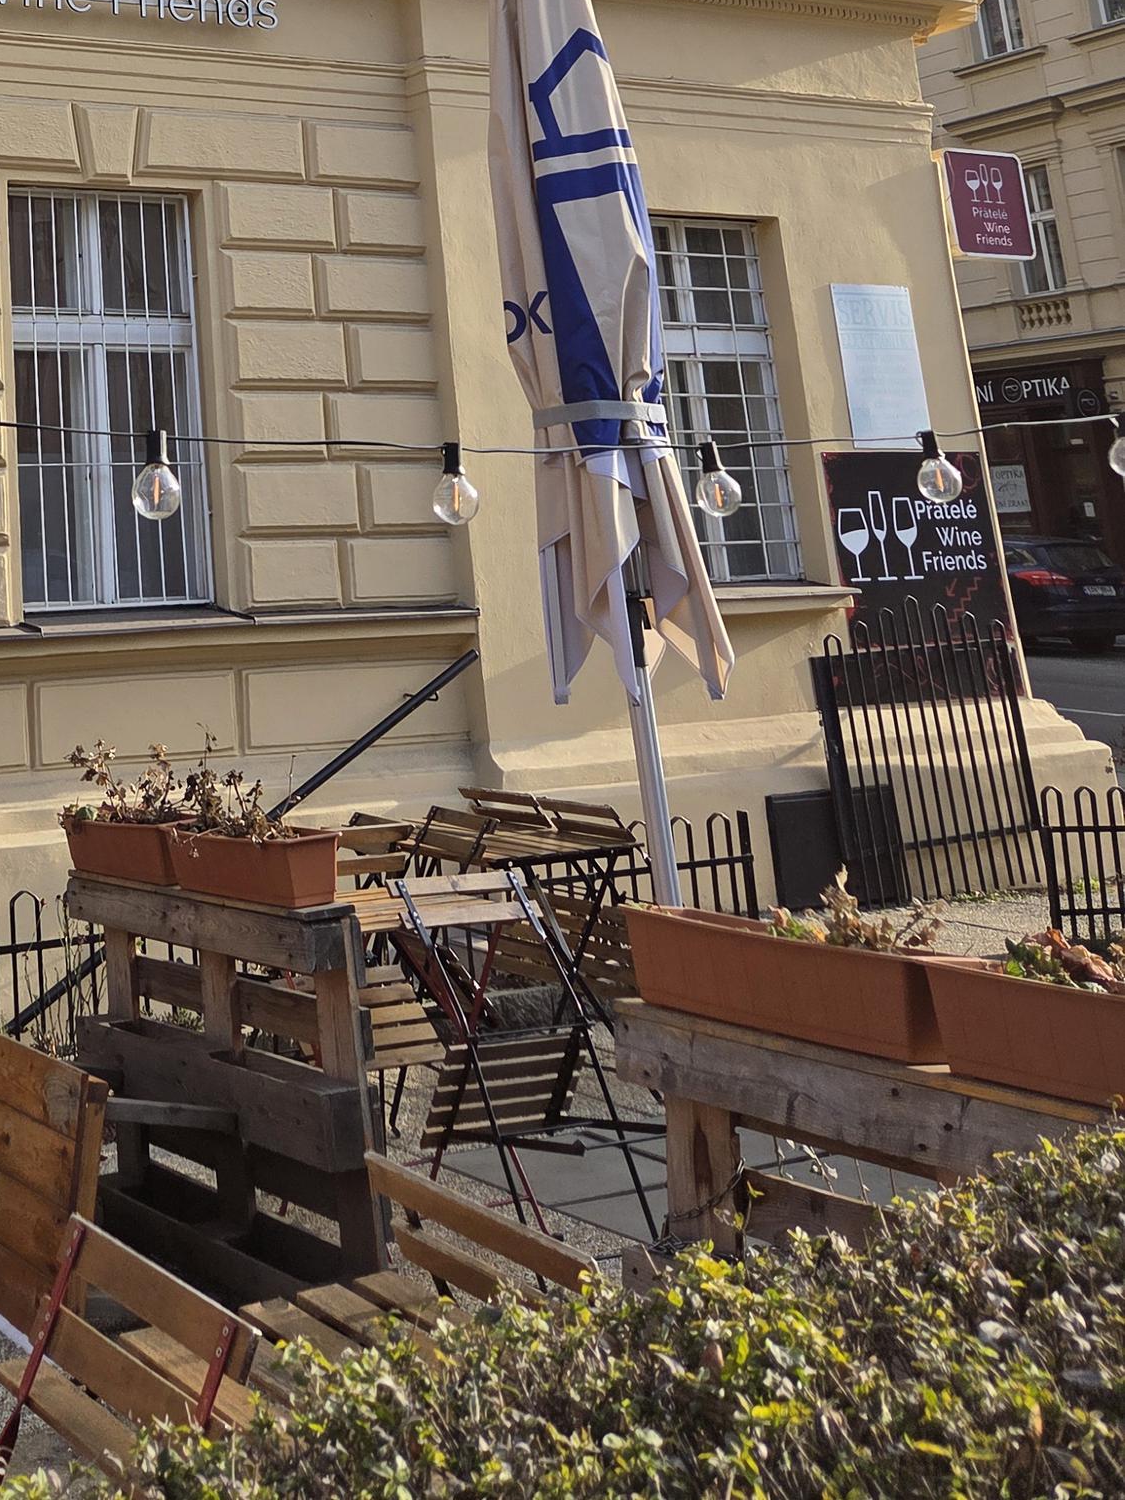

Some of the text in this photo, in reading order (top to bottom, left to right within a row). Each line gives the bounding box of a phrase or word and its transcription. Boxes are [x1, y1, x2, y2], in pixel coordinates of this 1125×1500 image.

[983, 222, 1011, 234] Wine
[976, 233, 1013, 247] Friends
[836, 297, 910, 326] SERVIS
[935, 526, 983, 547] Wine
[922, 550, 988, 572] Friends
